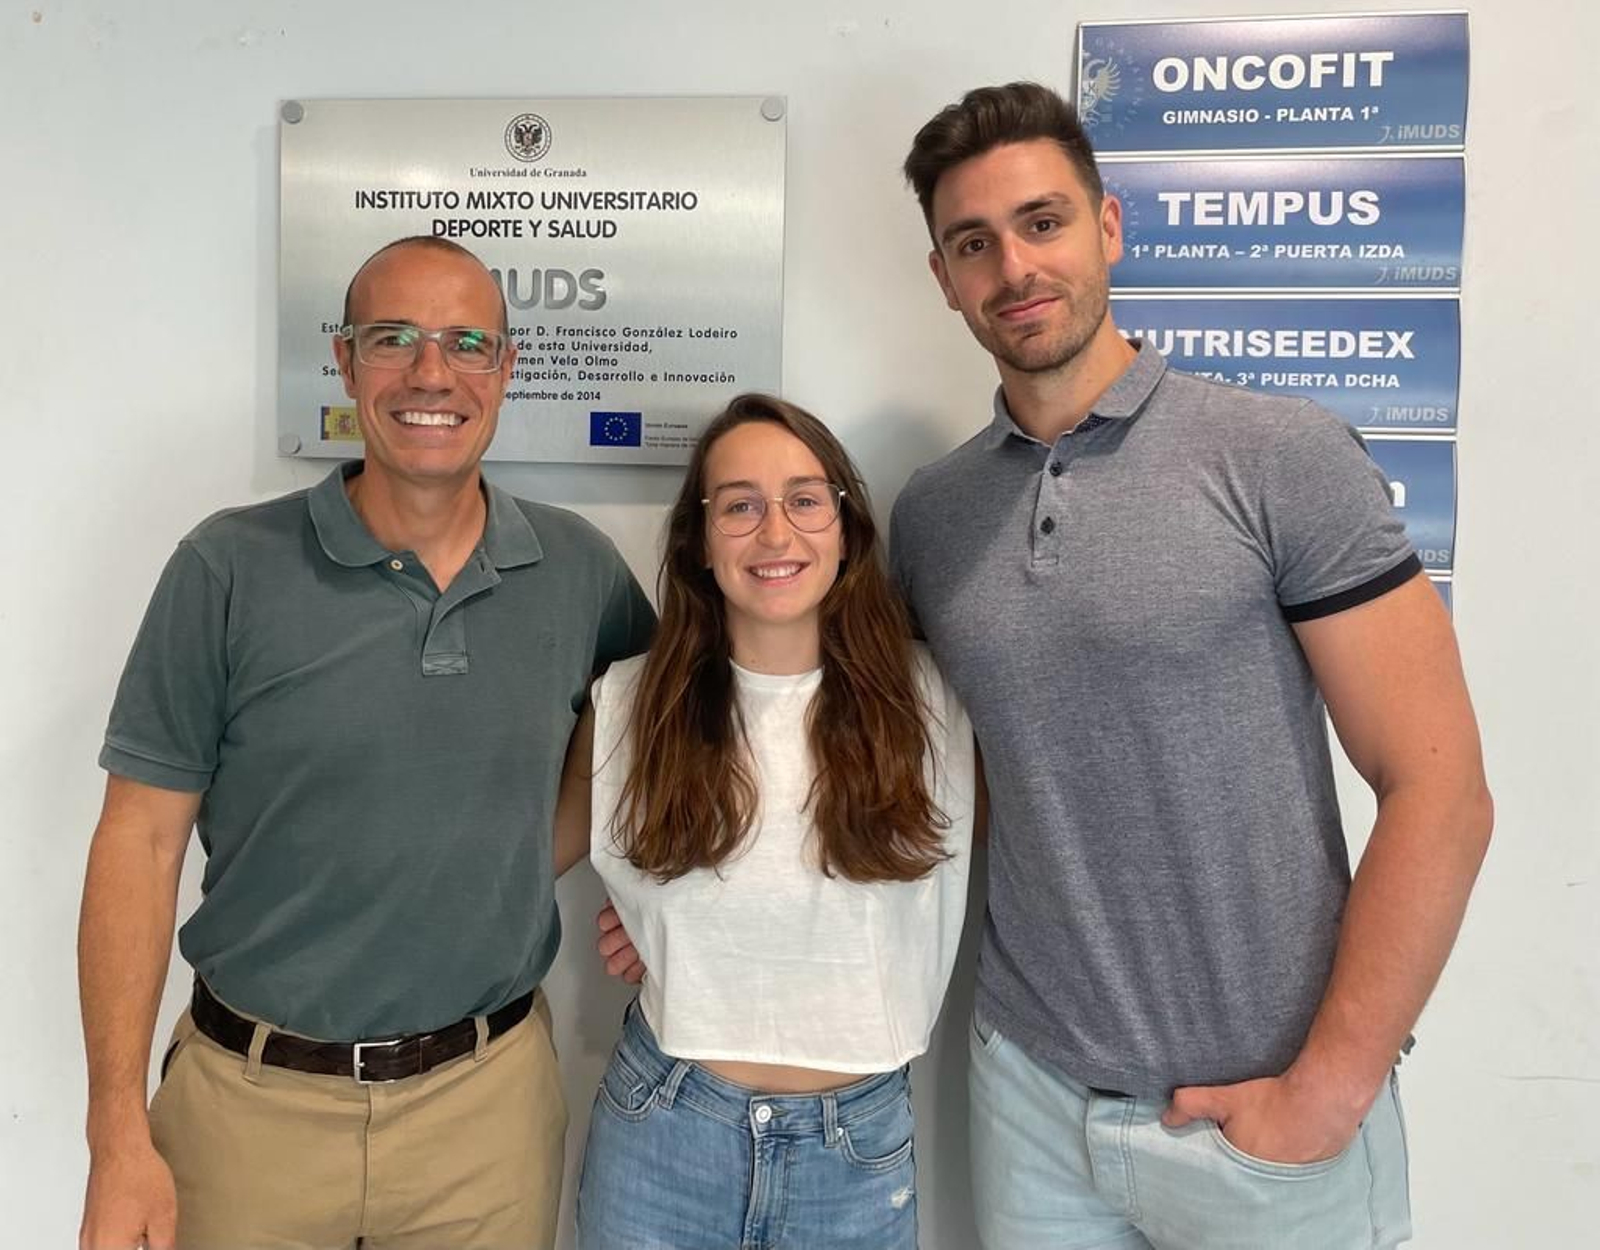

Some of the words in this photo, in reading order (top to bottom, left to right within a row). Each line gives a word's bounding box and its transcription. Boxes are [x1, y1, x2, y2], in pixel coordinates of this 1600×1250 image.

[1152, 51, 1394, 92] ONCOFIT
[1162, 109, 1259, 125] GIMNASIO
[1276, 107, 1354, 122] PLANTA
[1398, 124, 1460, 140] iMUDS
[469, 168, 527, 177] Universidad
[530, 168, 541, 177] de
[544, 168, 587, 177] Granada
[354, 191, 460, 210] INSTITUTO
[466, 191, 534, 210] MIXTO
[541, 191, 698, 211] UNIVERSITARIO
[1158, 190, 1381, 227] TEMPUS
[432, 219, 523, 238] DEPORTE
[528, 219, 542, 238] Y
[547, 219, 618, 239] SALUD
[1154, 244, 1230, 259] PLANTA
[1275, 244, 1352, 259] PUERTA
[1359, 244, 1405, 259] IZDA
[490, 267, 607, 312] UDS
[536, 325, 549, 337] D.
[555, 325, 617, 338] Francisco
[622, 326, 683, 338] González
[689, 327, 738, 339] Lodeiro
[517, 340, 532, 351] de
[538, 341, 566, 351] esta
[571, 340, 653, 354] Universidad,
[518, 355, 545, 366] men
[550, 355, 579, 366] Vela
[584, 355, 618, 366] Olmo
[510, 368, 572, 382] stigación,
[577, 370, 645, 382] Desarrollo
[650, 373, 658, 382] e
[663, 371, 736, 383] Innovación
[1261, 372, 1339, 387] PUERTA
[1345, 373, 1400, 388] DCHA
[504, 390, 559, 401] eptiembre
[560, 390, 574, 401] de
[577, 391, 601, 401] 2014
